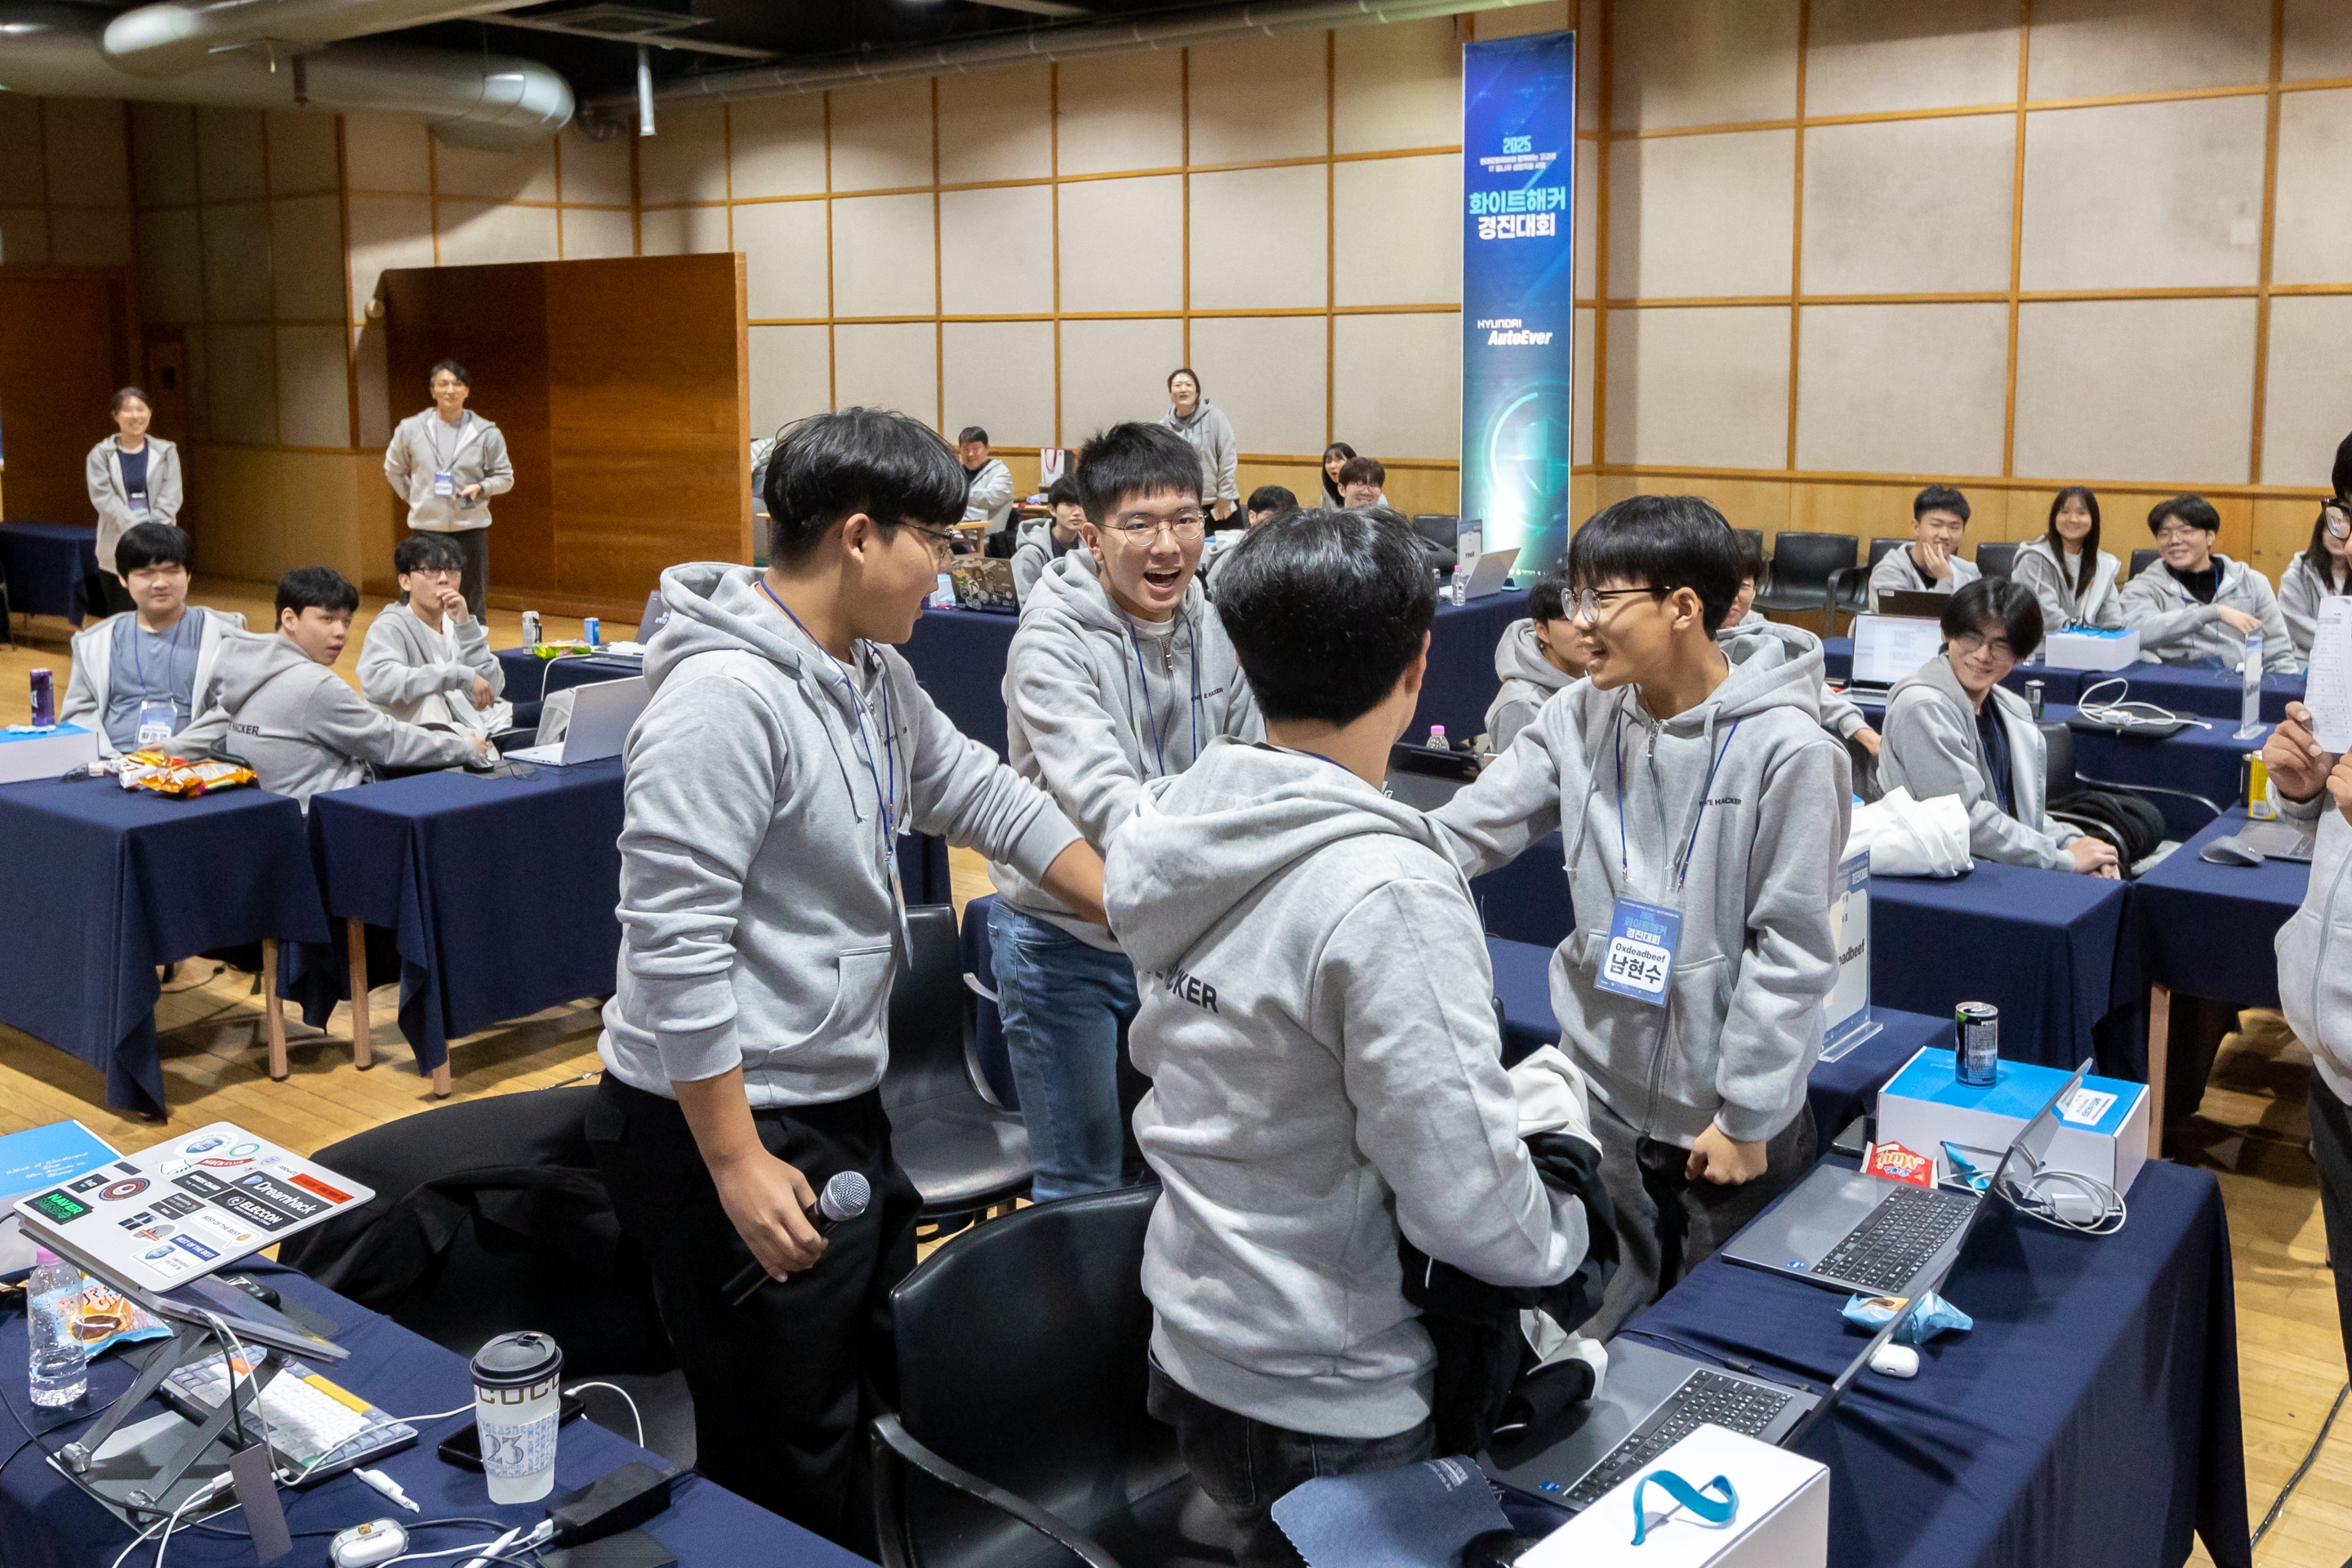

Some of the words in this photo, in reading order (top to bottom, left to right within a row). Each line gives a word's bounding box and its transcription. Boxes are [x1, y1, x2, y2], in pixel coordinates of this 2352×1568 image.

[1503, 135, 1532, 154] 2025
[1469, 186, 1566, 214] 화이트해커
[1478, 212, 1556, 240] 경진대회
[1477, 318, 1521, 328] HYUNDAI
[1488, 330, 1553, 345] AutoEver
[1715, 797, 1742, 806] HACKER
[1624, 915, 1668, 937] 화이트해커
[1626, 927, 1661, 945] 경진대회
[1610, 953, 1662, 984] 남현수
[1877, 1152, 1925, 1170] Mini
[47, 1193, 84, 1214] NAVER
[253, 1181, 318, 1214] Dreamhack
[239, 1200, 283, 1224] ELECCON
[202, 1215, 214, 1223] BEST
[227, 1227, 241, 1236] BEST
[176, 1236, 190, 1245] BEST
[192, 1245, 204, 1254] THE
[201, 1249, 216, 1258] BEST
